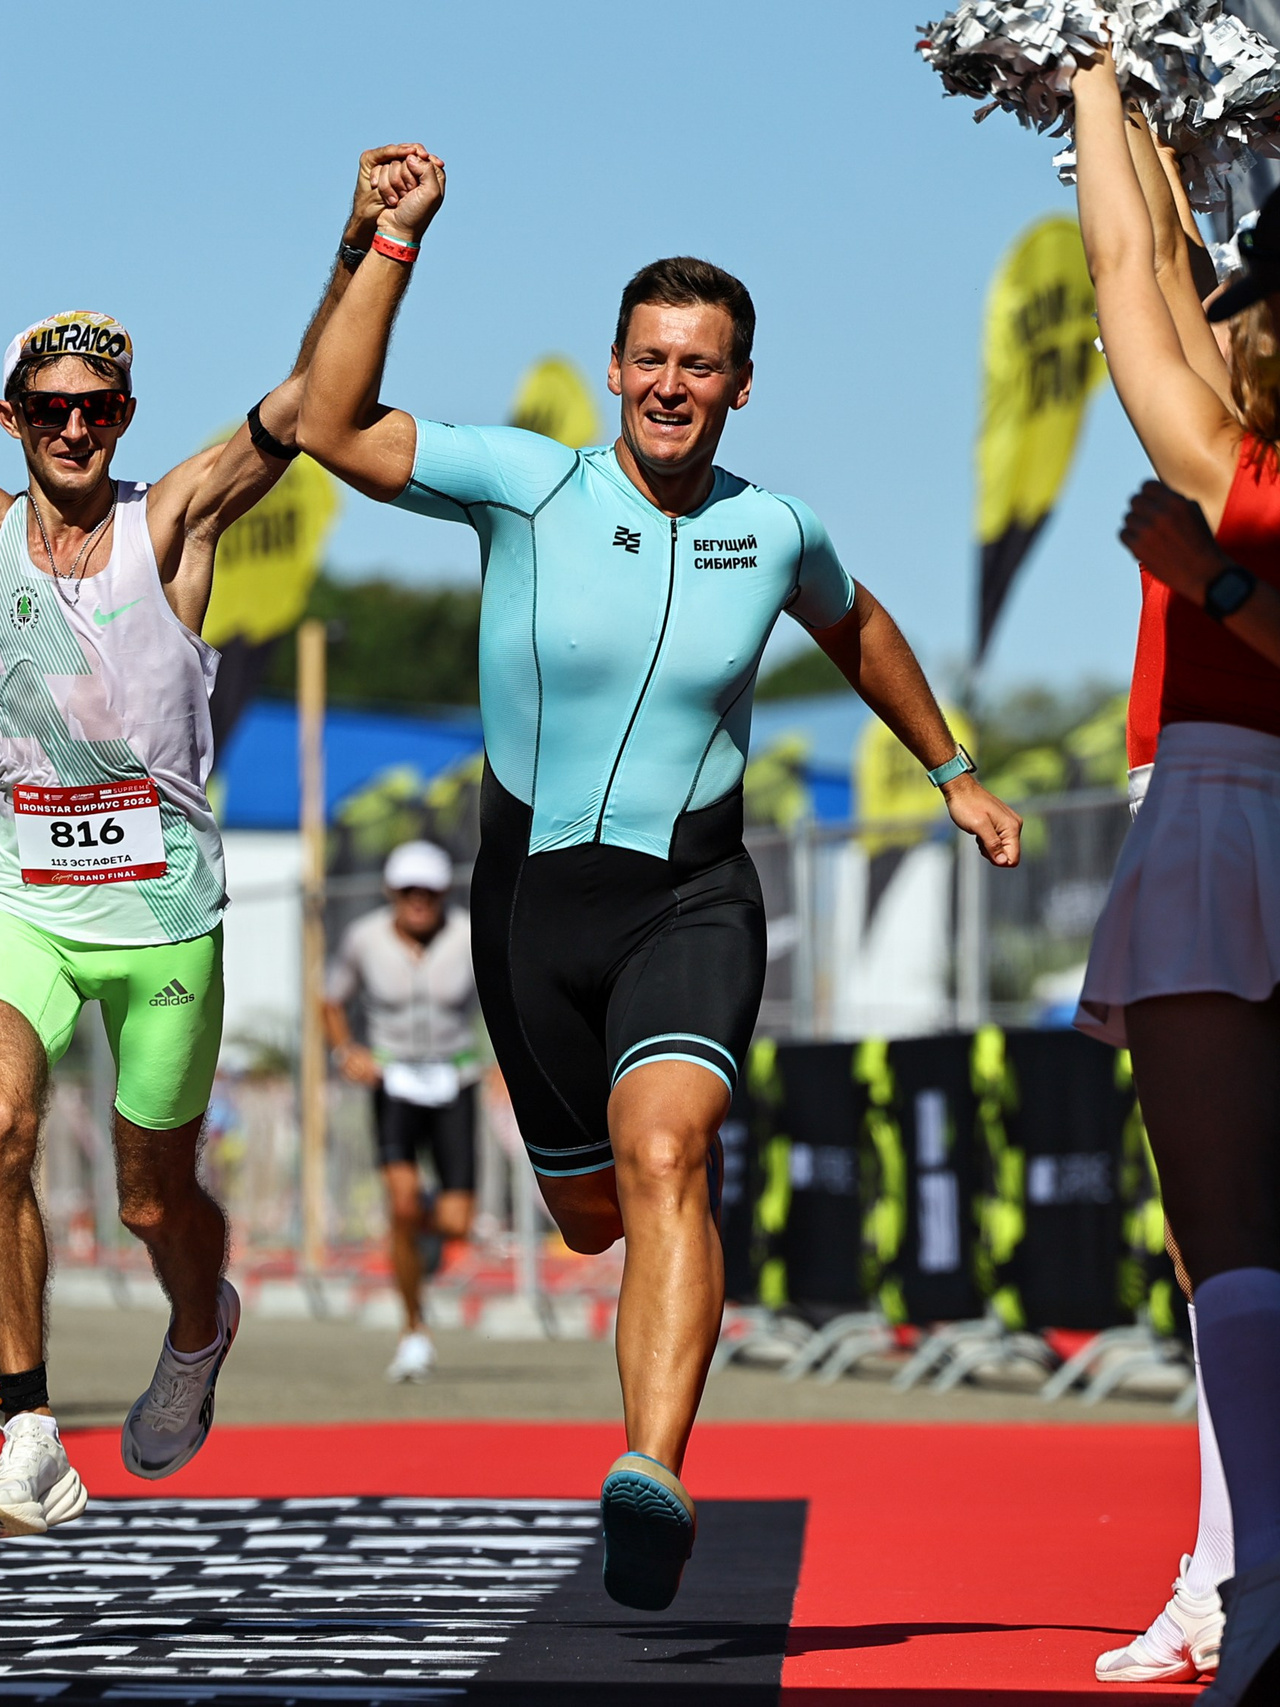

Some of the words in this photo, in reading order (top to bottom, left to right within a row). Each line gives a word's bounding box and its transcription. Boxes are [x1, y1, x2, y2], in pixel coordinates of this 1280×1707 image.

[30, 323, 126, 358] ULTRA100
[694, 534, 758, 553] БЕГУЩИЙ
[694, 556, 758, 570] СИБИРЯК
[113, 784, 150, 794] SUPREME
[19, 803, 71, 813] IRONSTAR
[74, 800, 120, 812] СИРИУС
[123, 797, 152, 807] 2026
[50, 818, 125, 848] 816
[51, 858, 68, 867] 113
[69, 854, 133, 867] ЭСТАФЕТА
[73, 873, 105, 881] GRAND
[107, 870, 137, 879] FINAL
[148, 993, 195, 1007] adidas
